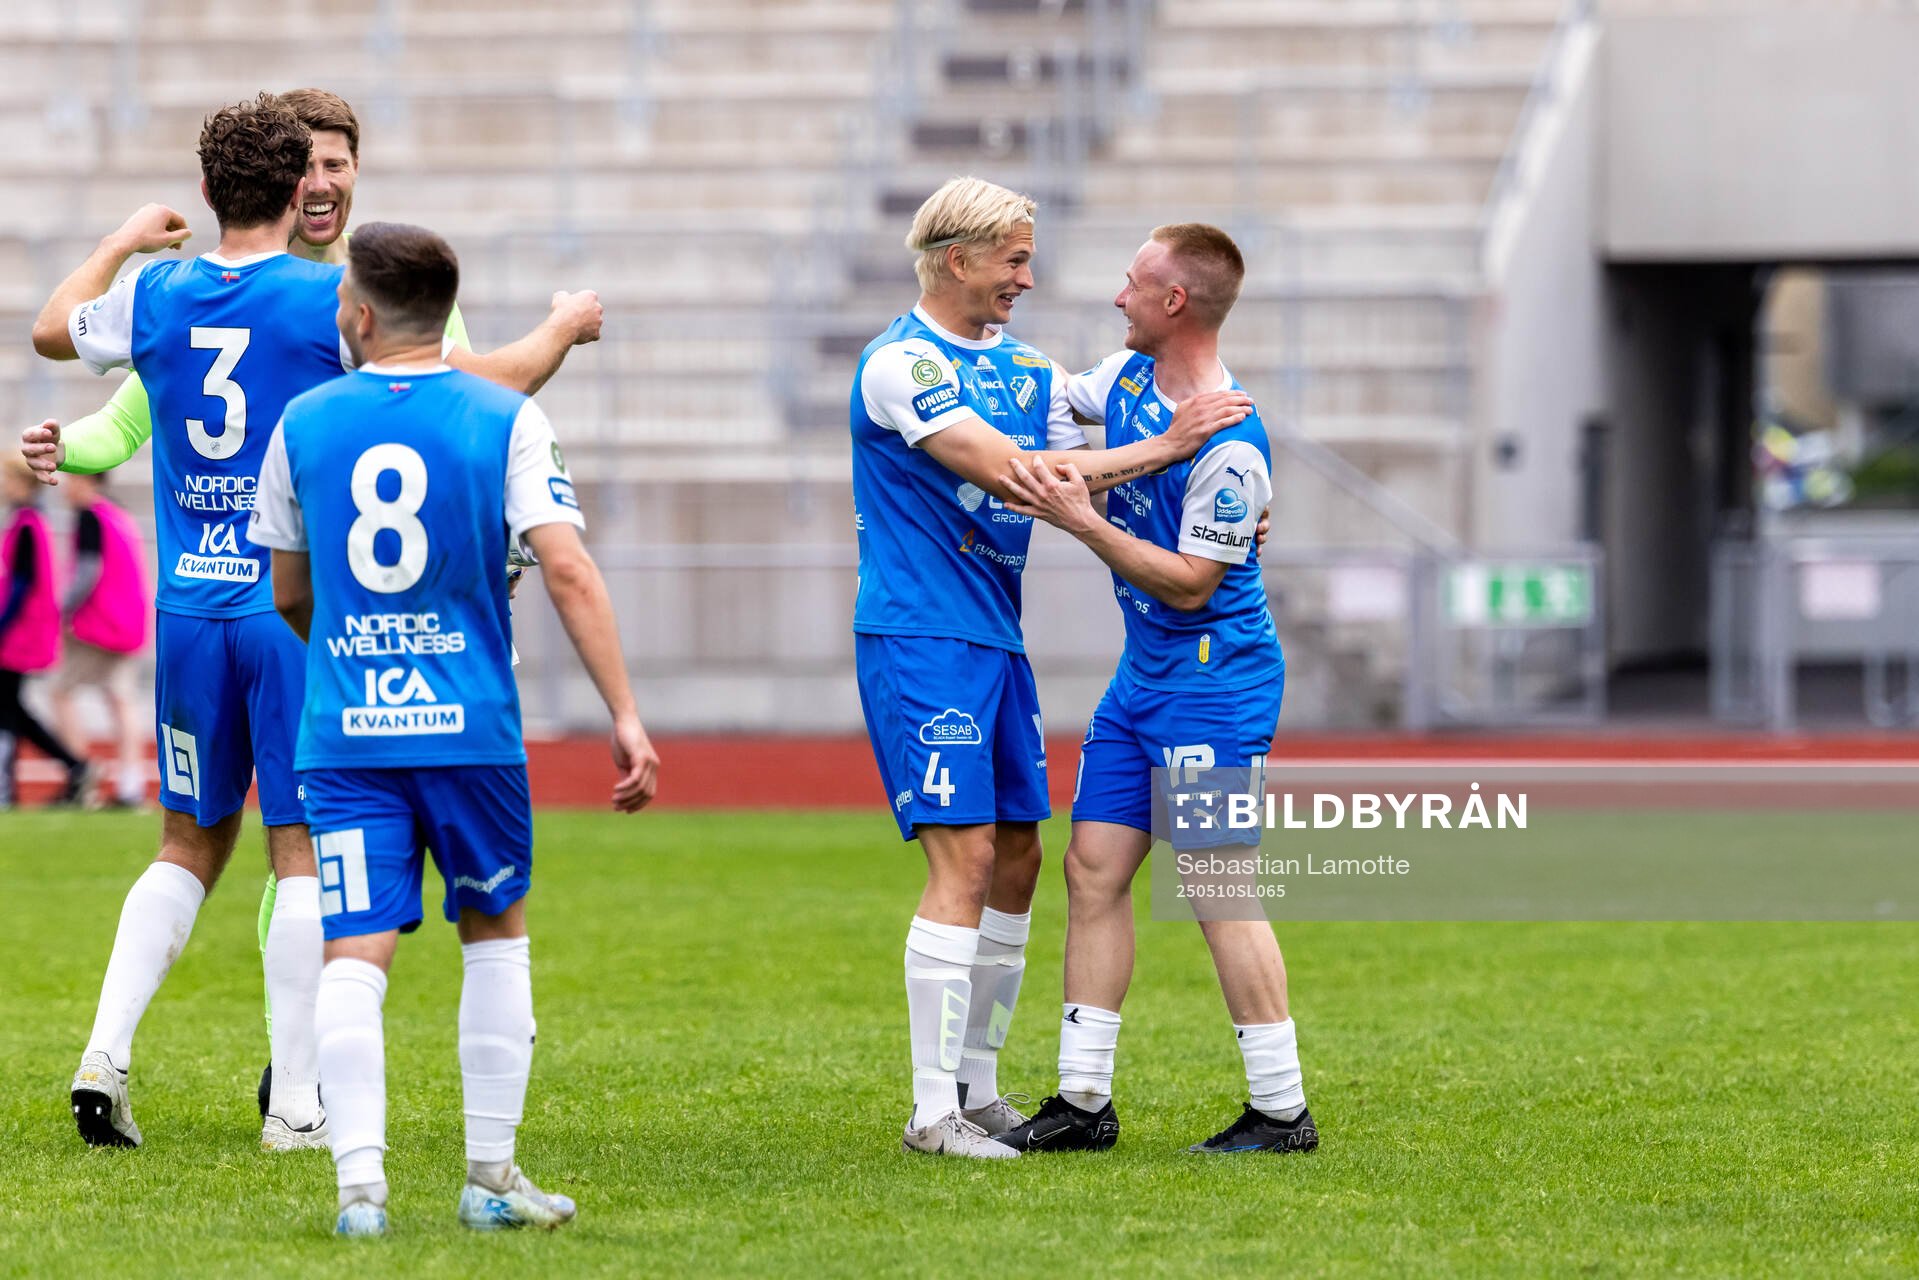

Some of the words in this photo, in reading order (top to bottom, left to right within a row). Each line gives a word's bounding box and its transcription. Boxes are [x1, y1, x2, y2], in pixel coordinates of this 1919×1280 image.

[186, 326, 251, 460] 3
[1010, 434, 1035, 447] SSON
[185, 475, 256, 493] NORDIC
[175, 490, 257, 511] WELLNES
[347, 442, 428, 594] 8
[992, 513, 1033, 523] GROUP
[198, 523, 241, 555] ICA
[1190, 525, 1252, 548] stadium
[180, 558, 254, 577] KVANTUM
[345, 612, 441, 636] NORDIC
[327, 632, 466, 658] WELLNESS
[364, 667, 438, 706] ICA
[350, 710, 457, 729] KVANTUM
[933, 724, 972, 736] SESAB
[922, 751, 956, 807] 4
